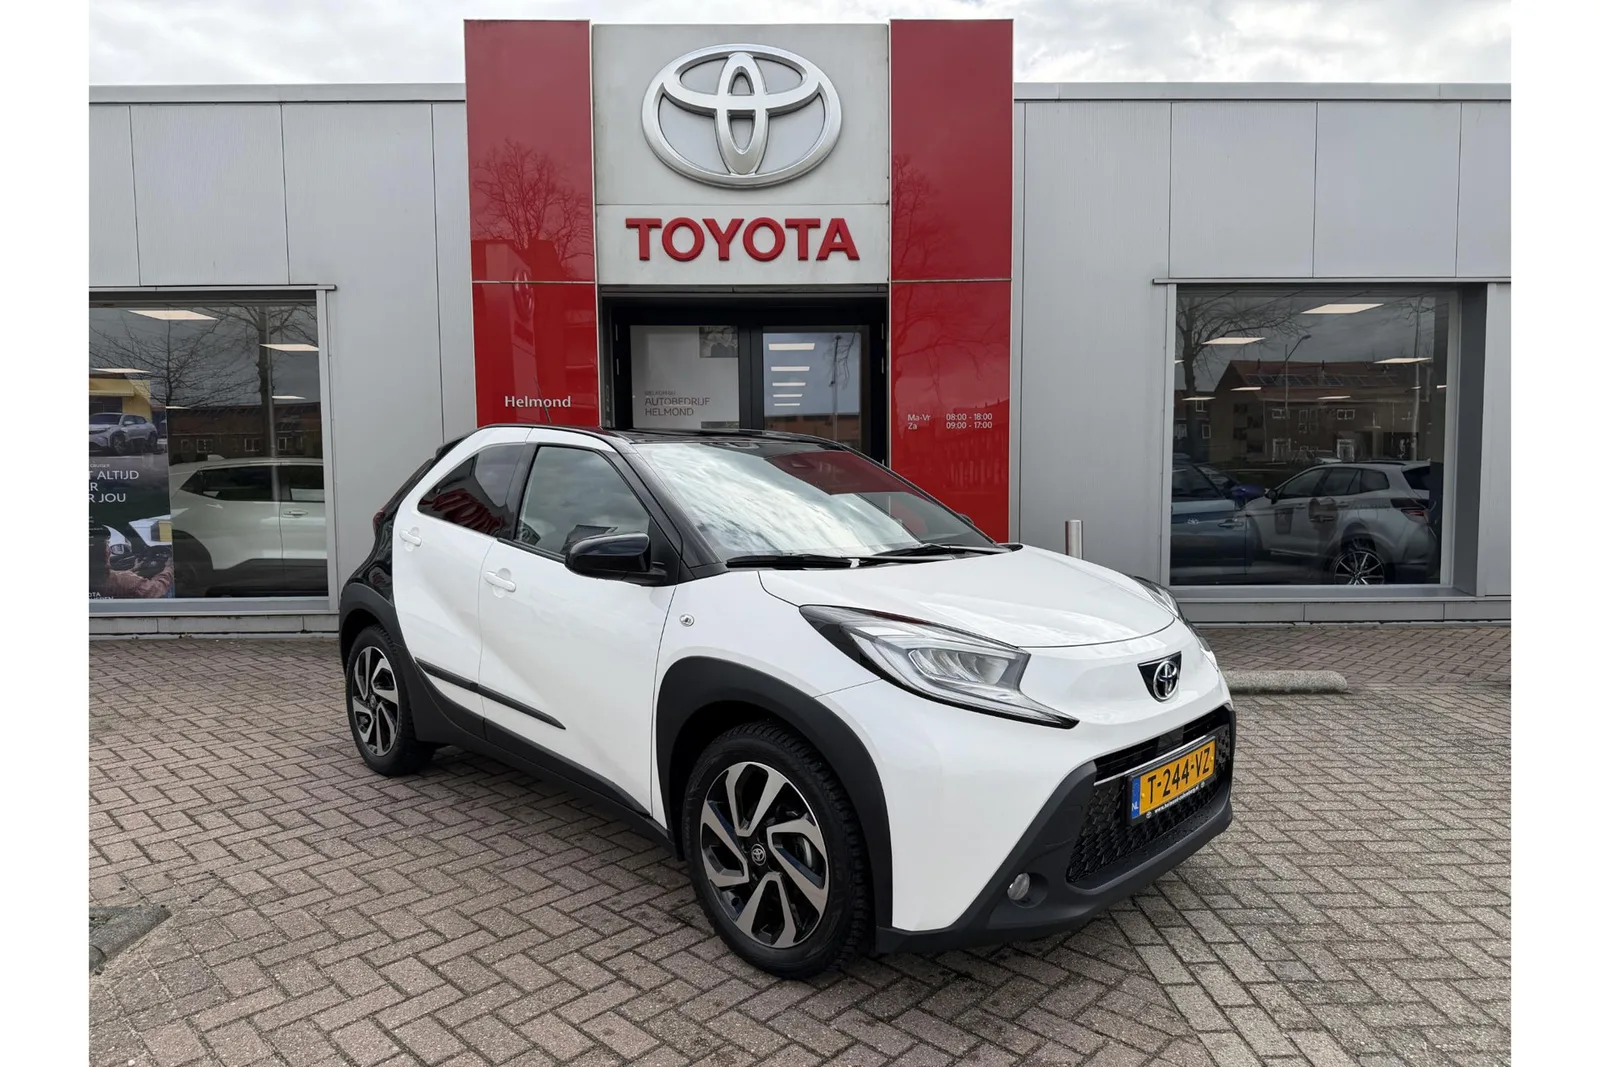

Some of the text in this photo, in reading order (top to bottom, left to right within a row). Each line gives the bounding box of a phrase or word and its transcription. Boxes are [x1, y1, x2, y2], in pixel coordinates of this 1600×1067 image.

[625, 217, 860, 262] TOYOTA
[504, 396, 571, 408] Helmond
[644, 397, 710, 406] AUTOBEDRIJF
[645, 407, 694, 417] HELMOND
[946, 413, 967, 421] 08:00
[973, 413, 993, 421] 18:00
[946, 421, 967, 429] 09:00
[973, 421, 993, 429] 17:00
[97, 470, 140, 480] ALTIJD
[98, 493, 126, 503] JOU
[1147, 747, 1211, 804] T-244-VZ
[1131, 801, 1139, 812] NL
